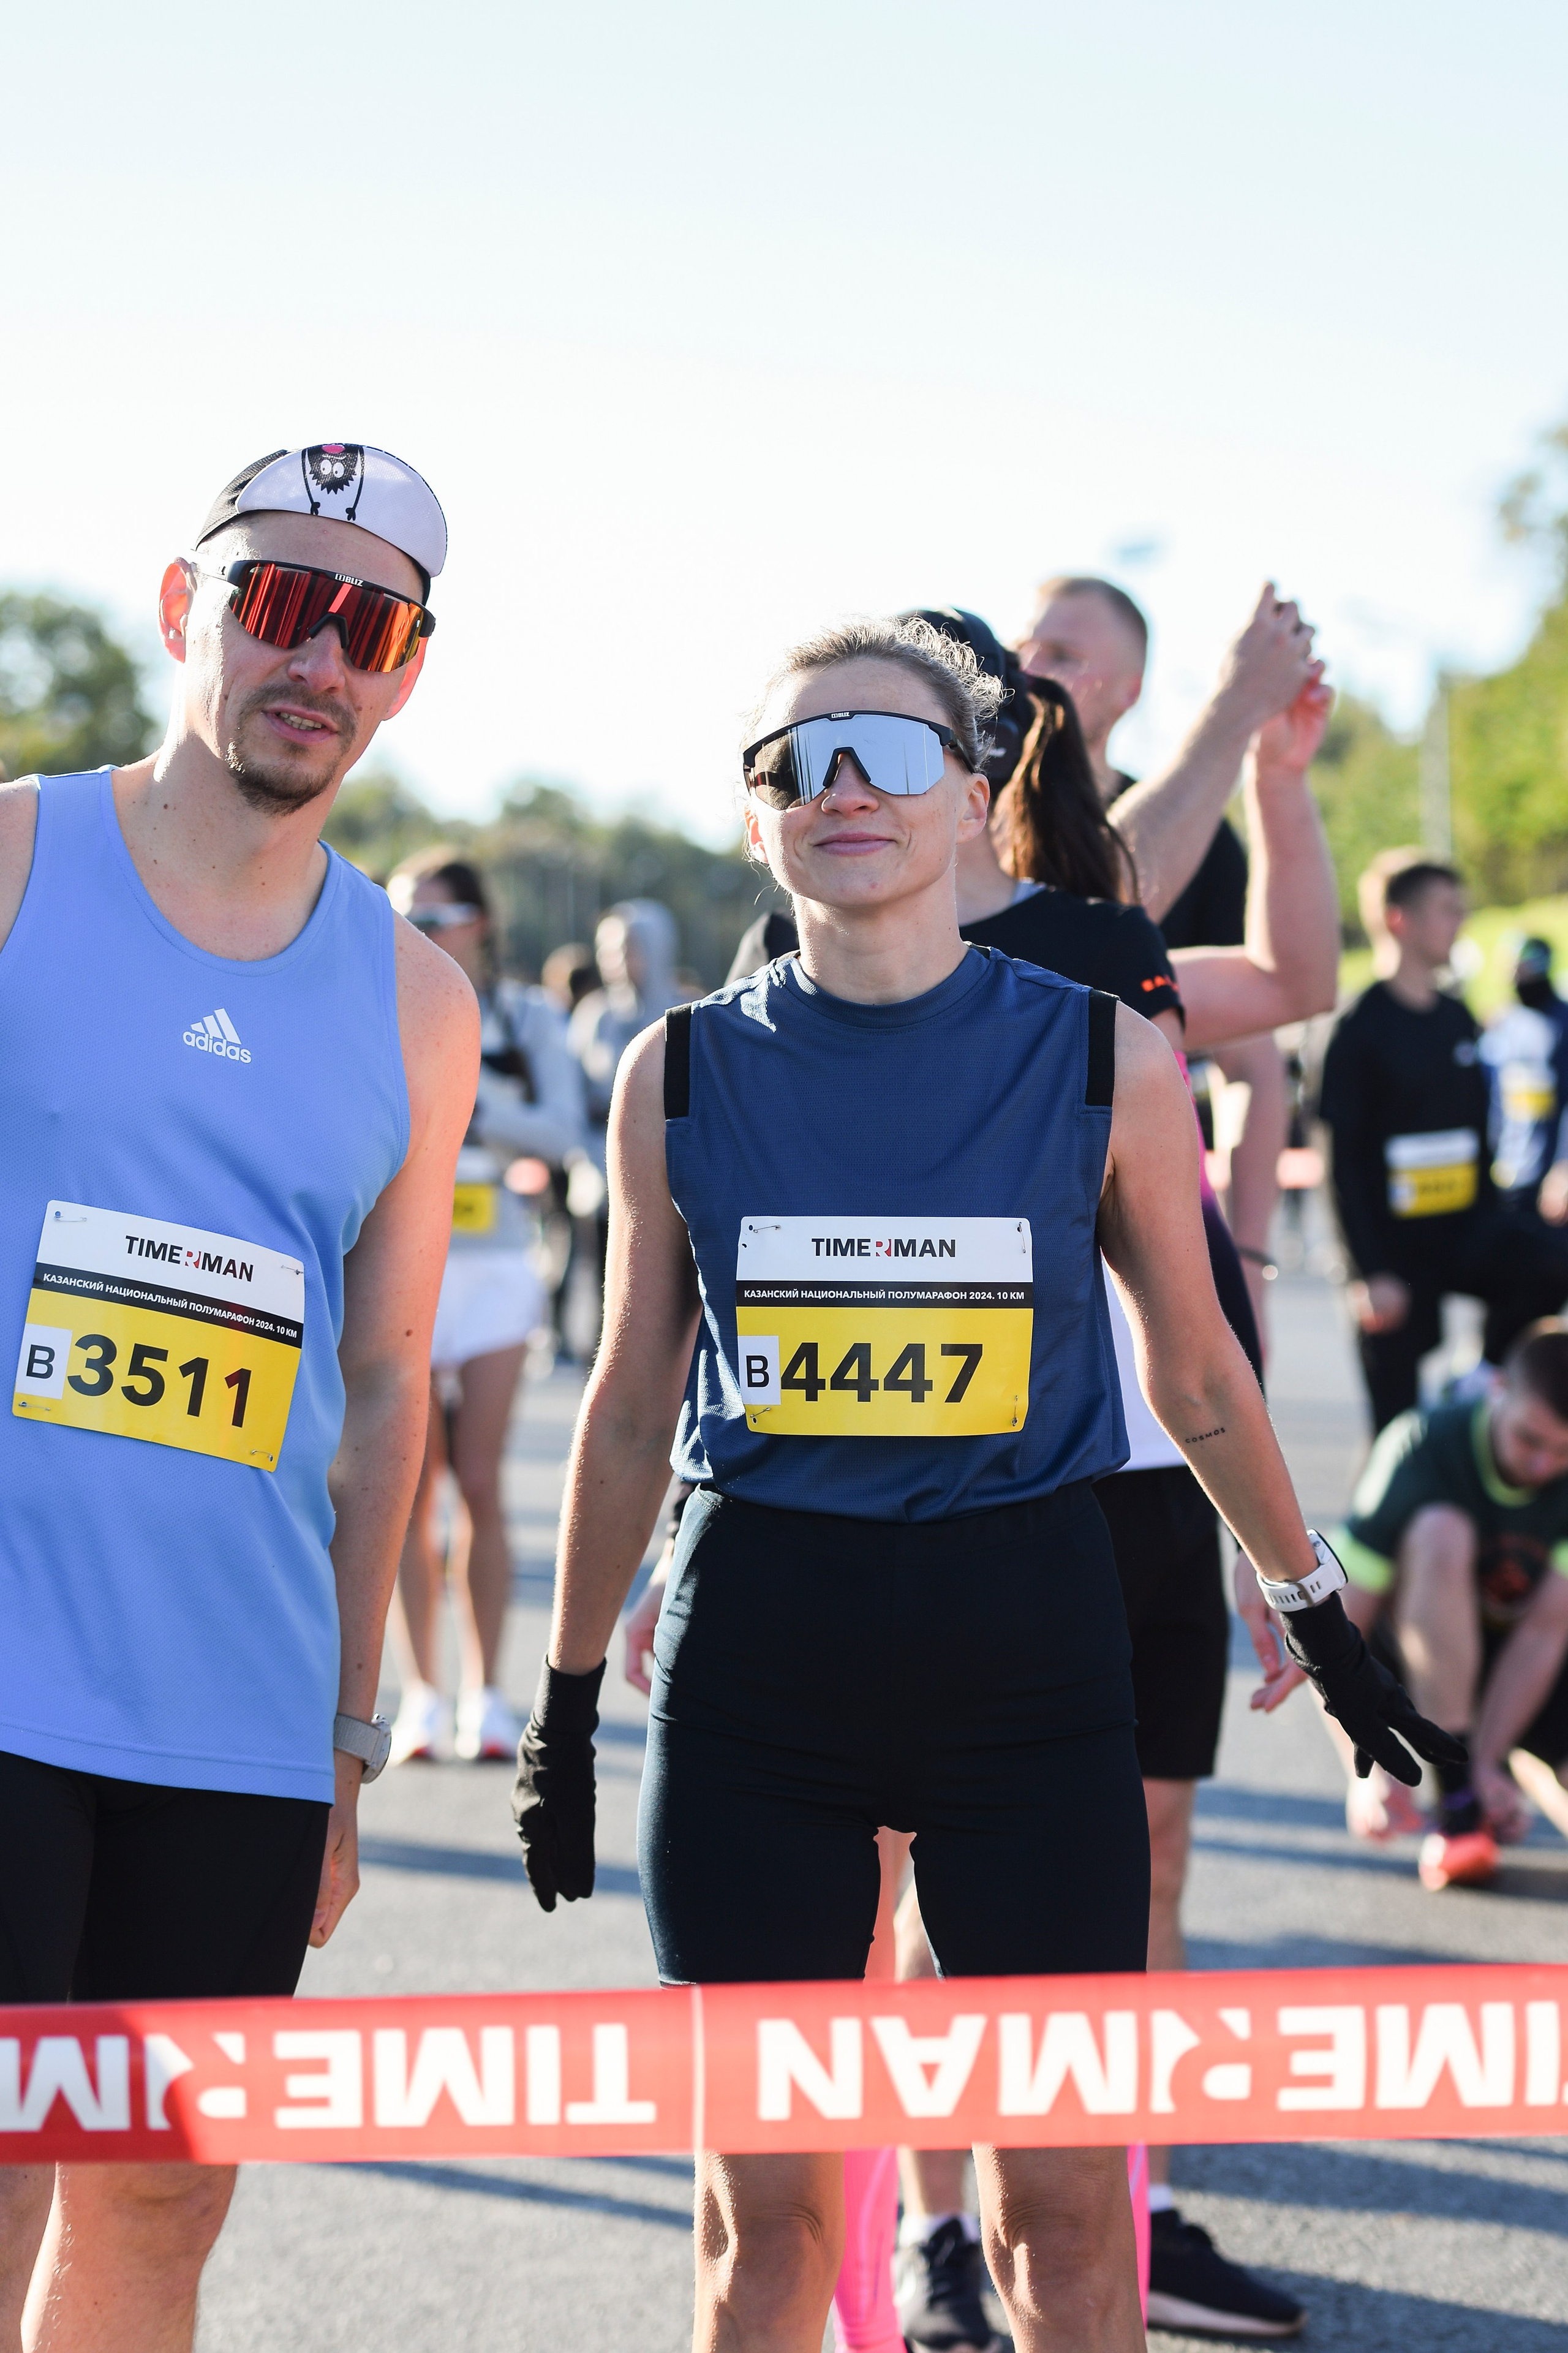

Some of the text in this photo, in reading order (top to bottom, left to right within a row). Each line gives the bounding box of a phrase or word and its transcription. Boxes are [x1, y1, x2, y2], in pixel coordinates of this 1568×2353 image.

[345, 576, 364, 587] BLIZ
[183, 1031, 252, 1063] adidas
[43, 1272, 298, 1339] КАЗАНСКИЙ НАЦИОНАЛЬНЫЙ ПОЛУМАРАФОН 2024. 10 КМ
[744, 1288, 1025, 1302] КАЗАНСКИЙ НАЦИОНАЛЬНЫЙ ПОЛУМАРАФОН 2024. 10 КМ
[67, 1333, 252, 1428] 3511
[780, 1342, 984, 1403] 4447
[1185, 1427, 1226, 1443] COSMOS
